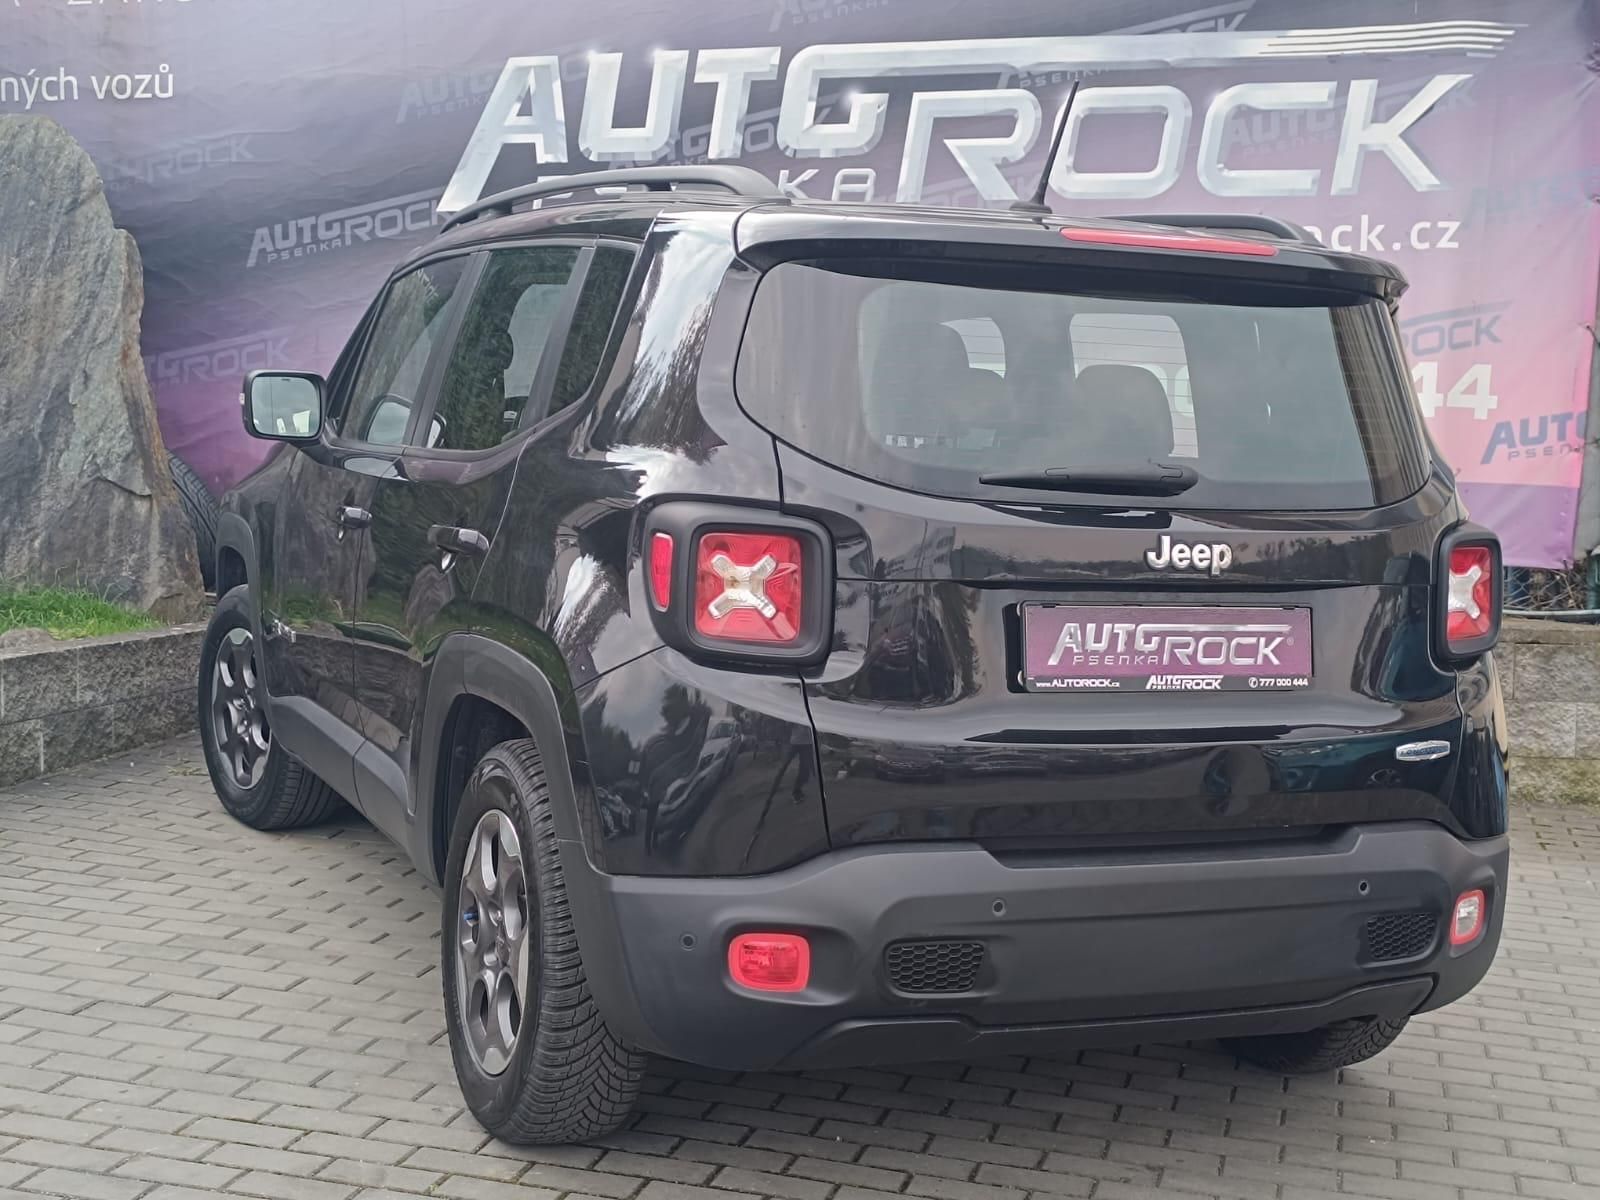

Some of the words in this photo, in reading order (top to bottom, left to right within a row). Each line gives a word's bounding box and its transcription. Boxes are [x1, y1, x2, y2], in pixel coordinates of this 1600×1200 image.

[0, 67, 79, 110] ných
[90, 63, 174, 100] vozů
[267, 238, 343, 264] PSENKA
[1146, 535, 1233, 575] Jeep
[1072, 655, 1159, 666] PSENKA
[1259, 678, 1275, 687] 777
[1276, 678, 1291, 687] 000
[1292, 677, 1308, 687] 444
